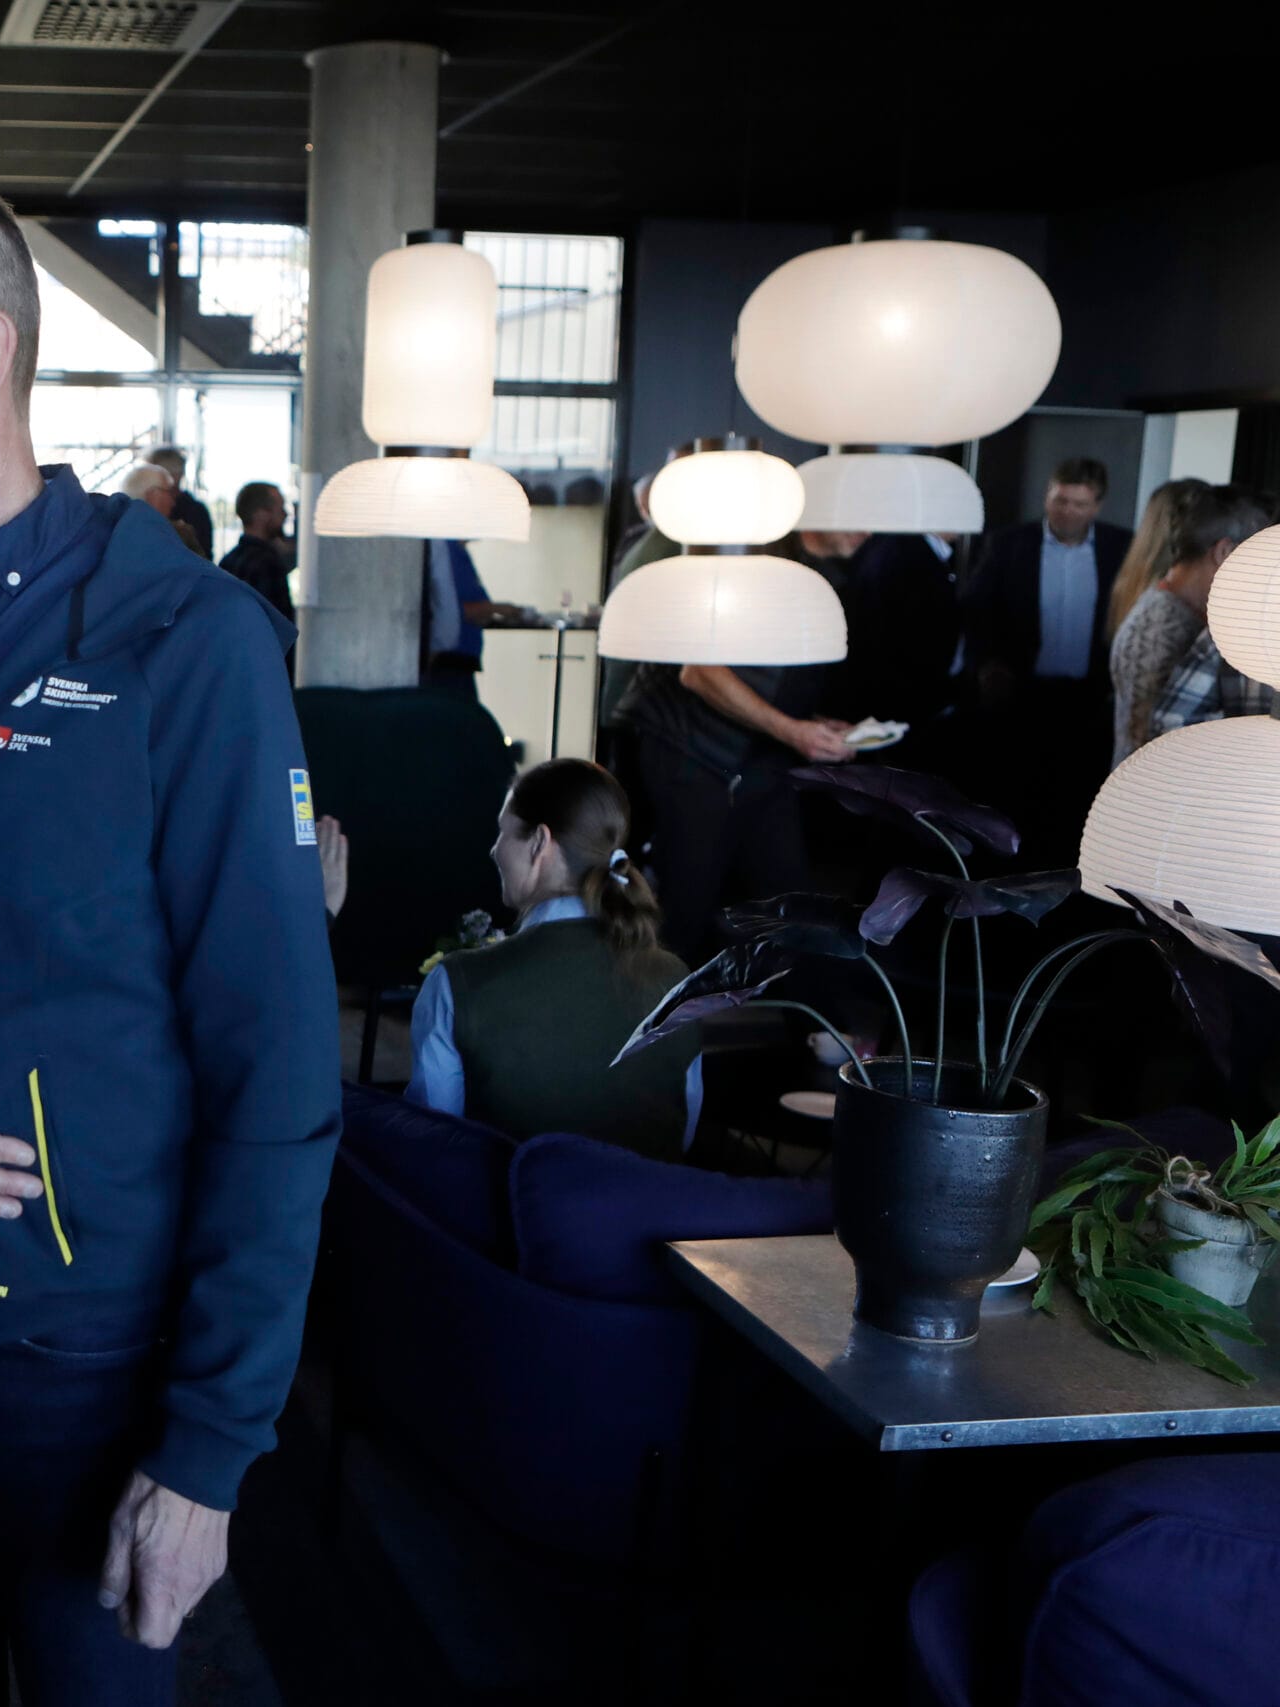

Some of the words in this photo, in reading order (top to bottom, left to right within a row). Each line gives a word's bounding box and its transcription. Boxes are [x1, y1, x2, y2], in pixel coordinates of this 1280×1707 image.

[47, 676, 89, 693] SVENSKA
[7, 741, 28, 752] SPEL
[11, 732, 52, 747] SVENSKA
